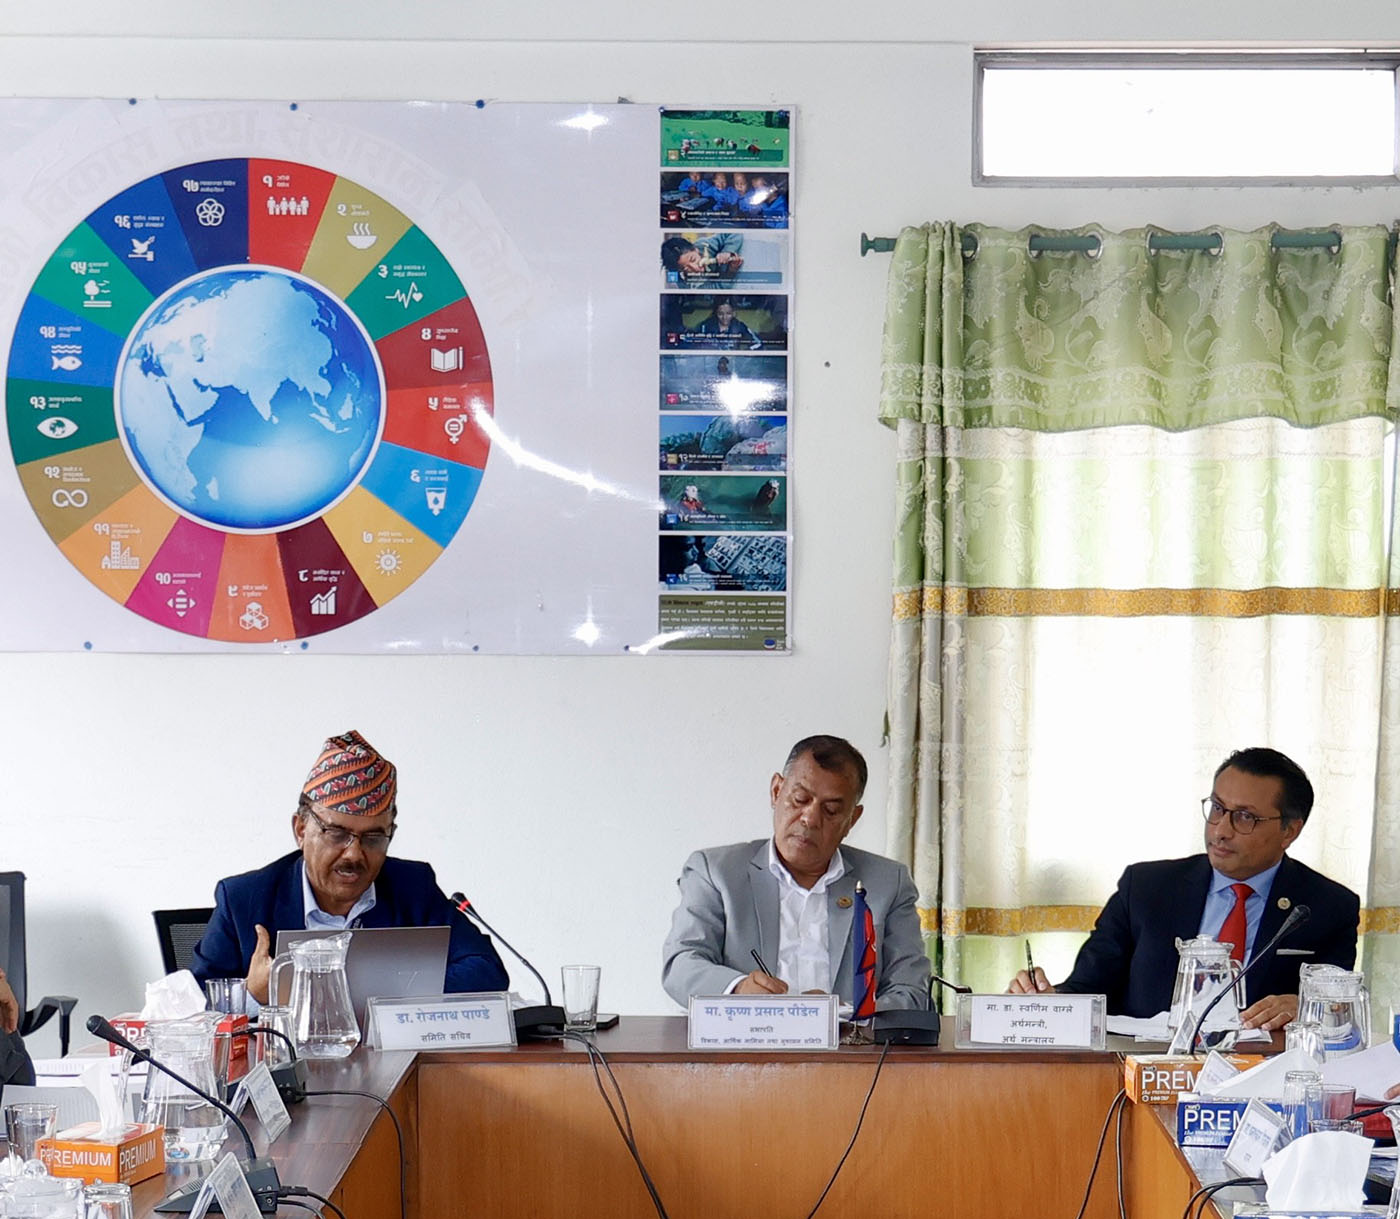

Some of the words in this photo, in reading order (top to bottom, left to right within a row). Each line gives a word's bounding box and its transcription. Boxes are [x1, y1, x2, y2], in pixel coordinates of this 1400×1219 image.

[378, 264, 389, 278] ३
[704, 1006, 721, 1017] मा.
[725, 1006, 750, 1021] कृष्ण
[754, 1007, 785, 1018] प्रसाद
[1019, 1002, 1048, 1012] स्वर्णिम
[396, 1012, 413, 1024] डा.
[415, 1008, 458, 1023] रोजनाथ
[461, 1005, 490, 1020] पाण्डे
[420, 1032, 446, 1042] समिति
[1002, 1035, 1016, 1044] अर्थ
[1021, 1036, 1055, 1044] मन्त्रालय
[1141, 1070, 1199, 1090] PREM
